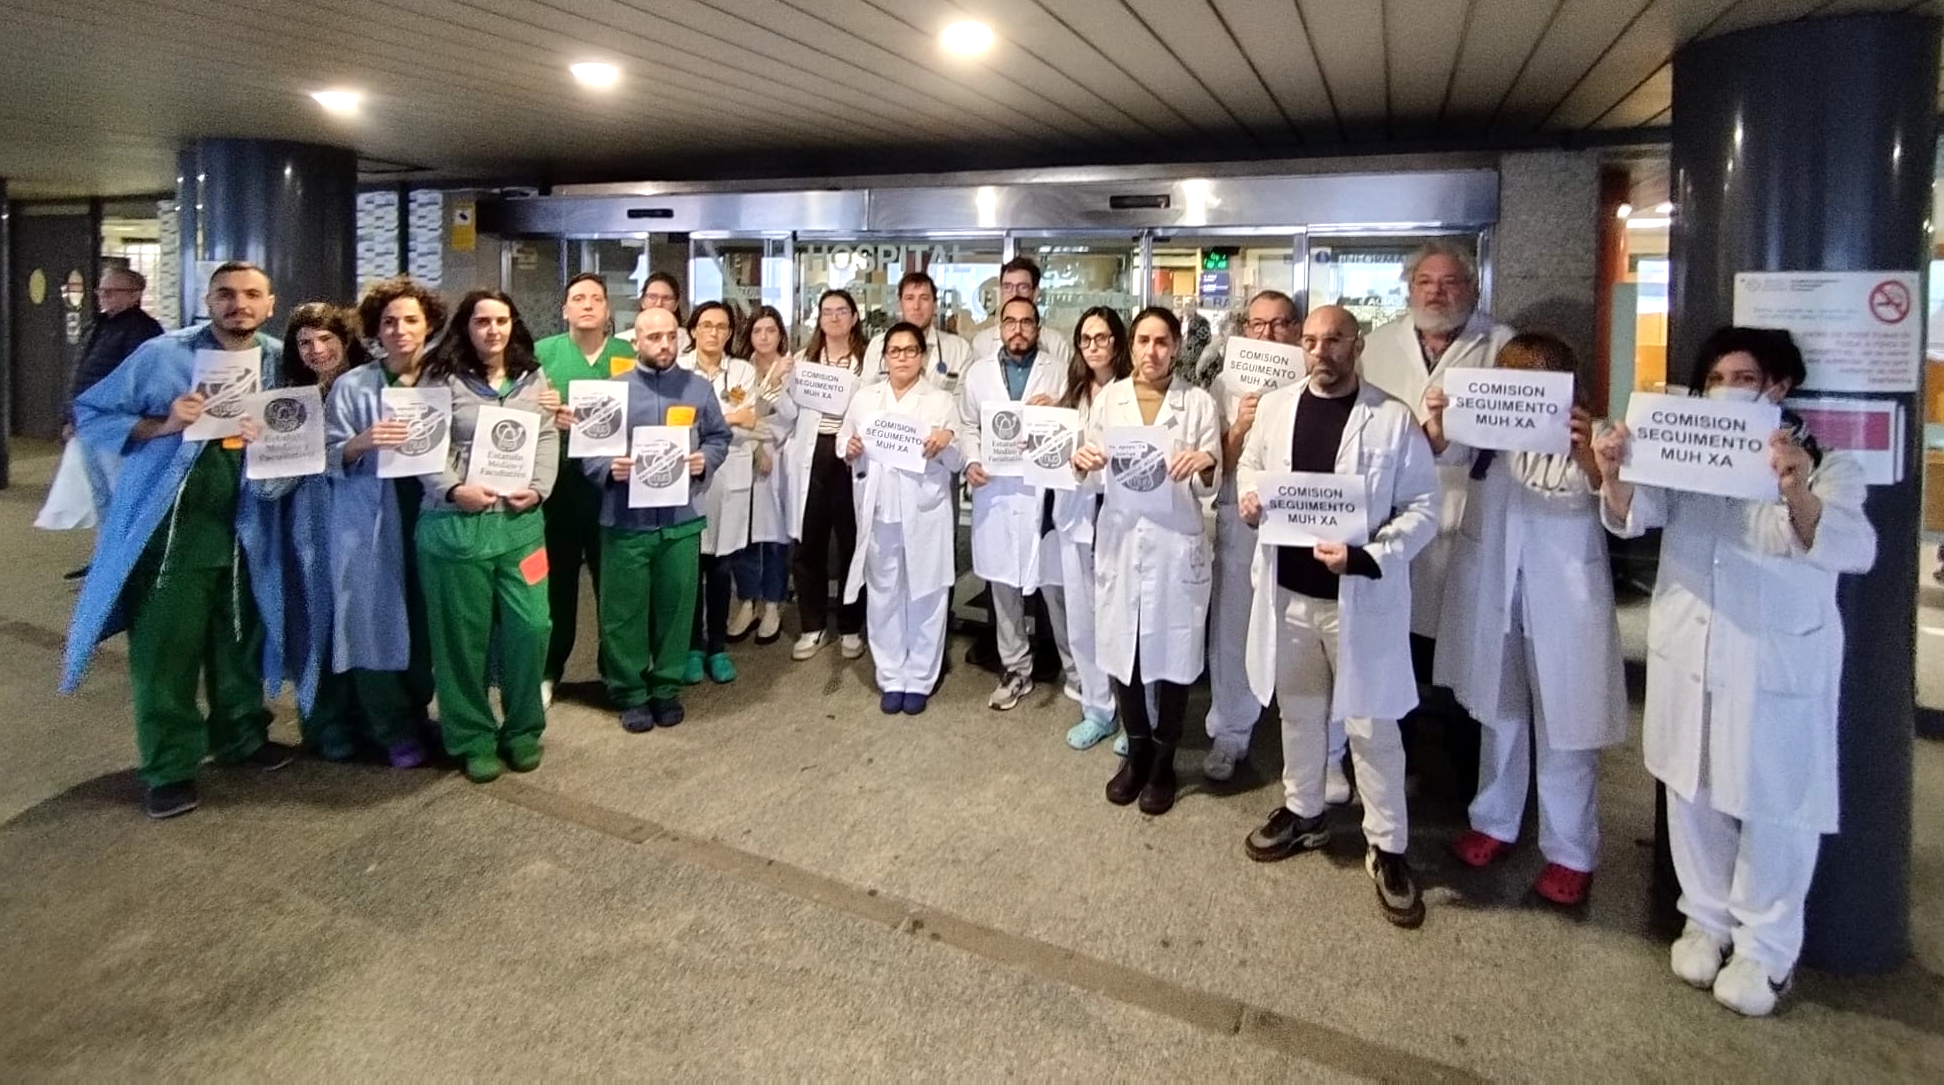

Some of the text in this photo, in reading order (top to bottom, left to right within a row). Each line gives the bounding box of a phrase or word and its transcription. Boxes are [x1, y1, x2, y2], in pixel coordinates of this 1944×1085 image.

[807, 244, 966, 273] HOSPITAL
[1239, 349, 1289, 366] COMISION
[801, 370, 839, 382] COMISION
[1230, 361, 1296, 380] SEGUIMENTO
[795, 378, 844, 393] SEGUIMENTO
[1240, 374, 1278, 389] MUH XA
[803, 388, 832, 400] MUH XA
[1468, 382, 1545, 398] COMISION
[1456, 396, 1558, 415] SEGUIMENTO
[874, 419, 917, 434] COMISION
[1476, 414, 1536, 429] MUH XA
[1651, 411, 1746, 432] COMISION
[866, 427, 923, 446] SEGUIMENTO
[1637, 426, 1763, 453] SEGUIMENTO
[876, 440, 909, 454] MUH XA
[1661, 447, 1733, 468] MUH XA
[1278, 486, 1343, 499] COMISION
[1269, 499, 1355, 513] SEGUIMENTO
[1288, 513, 1338, 526] MUH XA
